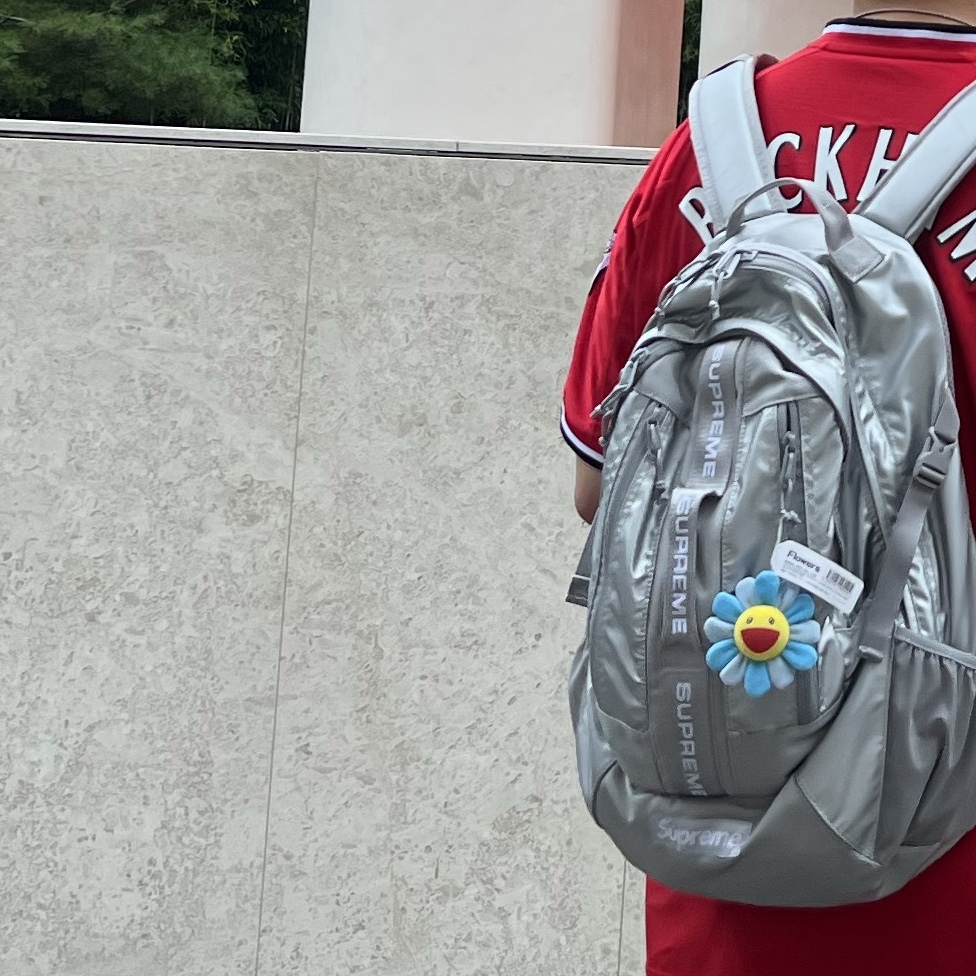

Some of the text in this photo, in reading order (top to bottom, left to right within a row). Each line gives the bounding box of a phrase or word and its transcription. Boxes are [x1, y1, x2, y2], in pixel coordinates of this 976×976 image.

[702, 344, 726, 478] SUPREME
[671, 495, 693, 635] SUPREME
[786, 549, 821, 573] Flowers
